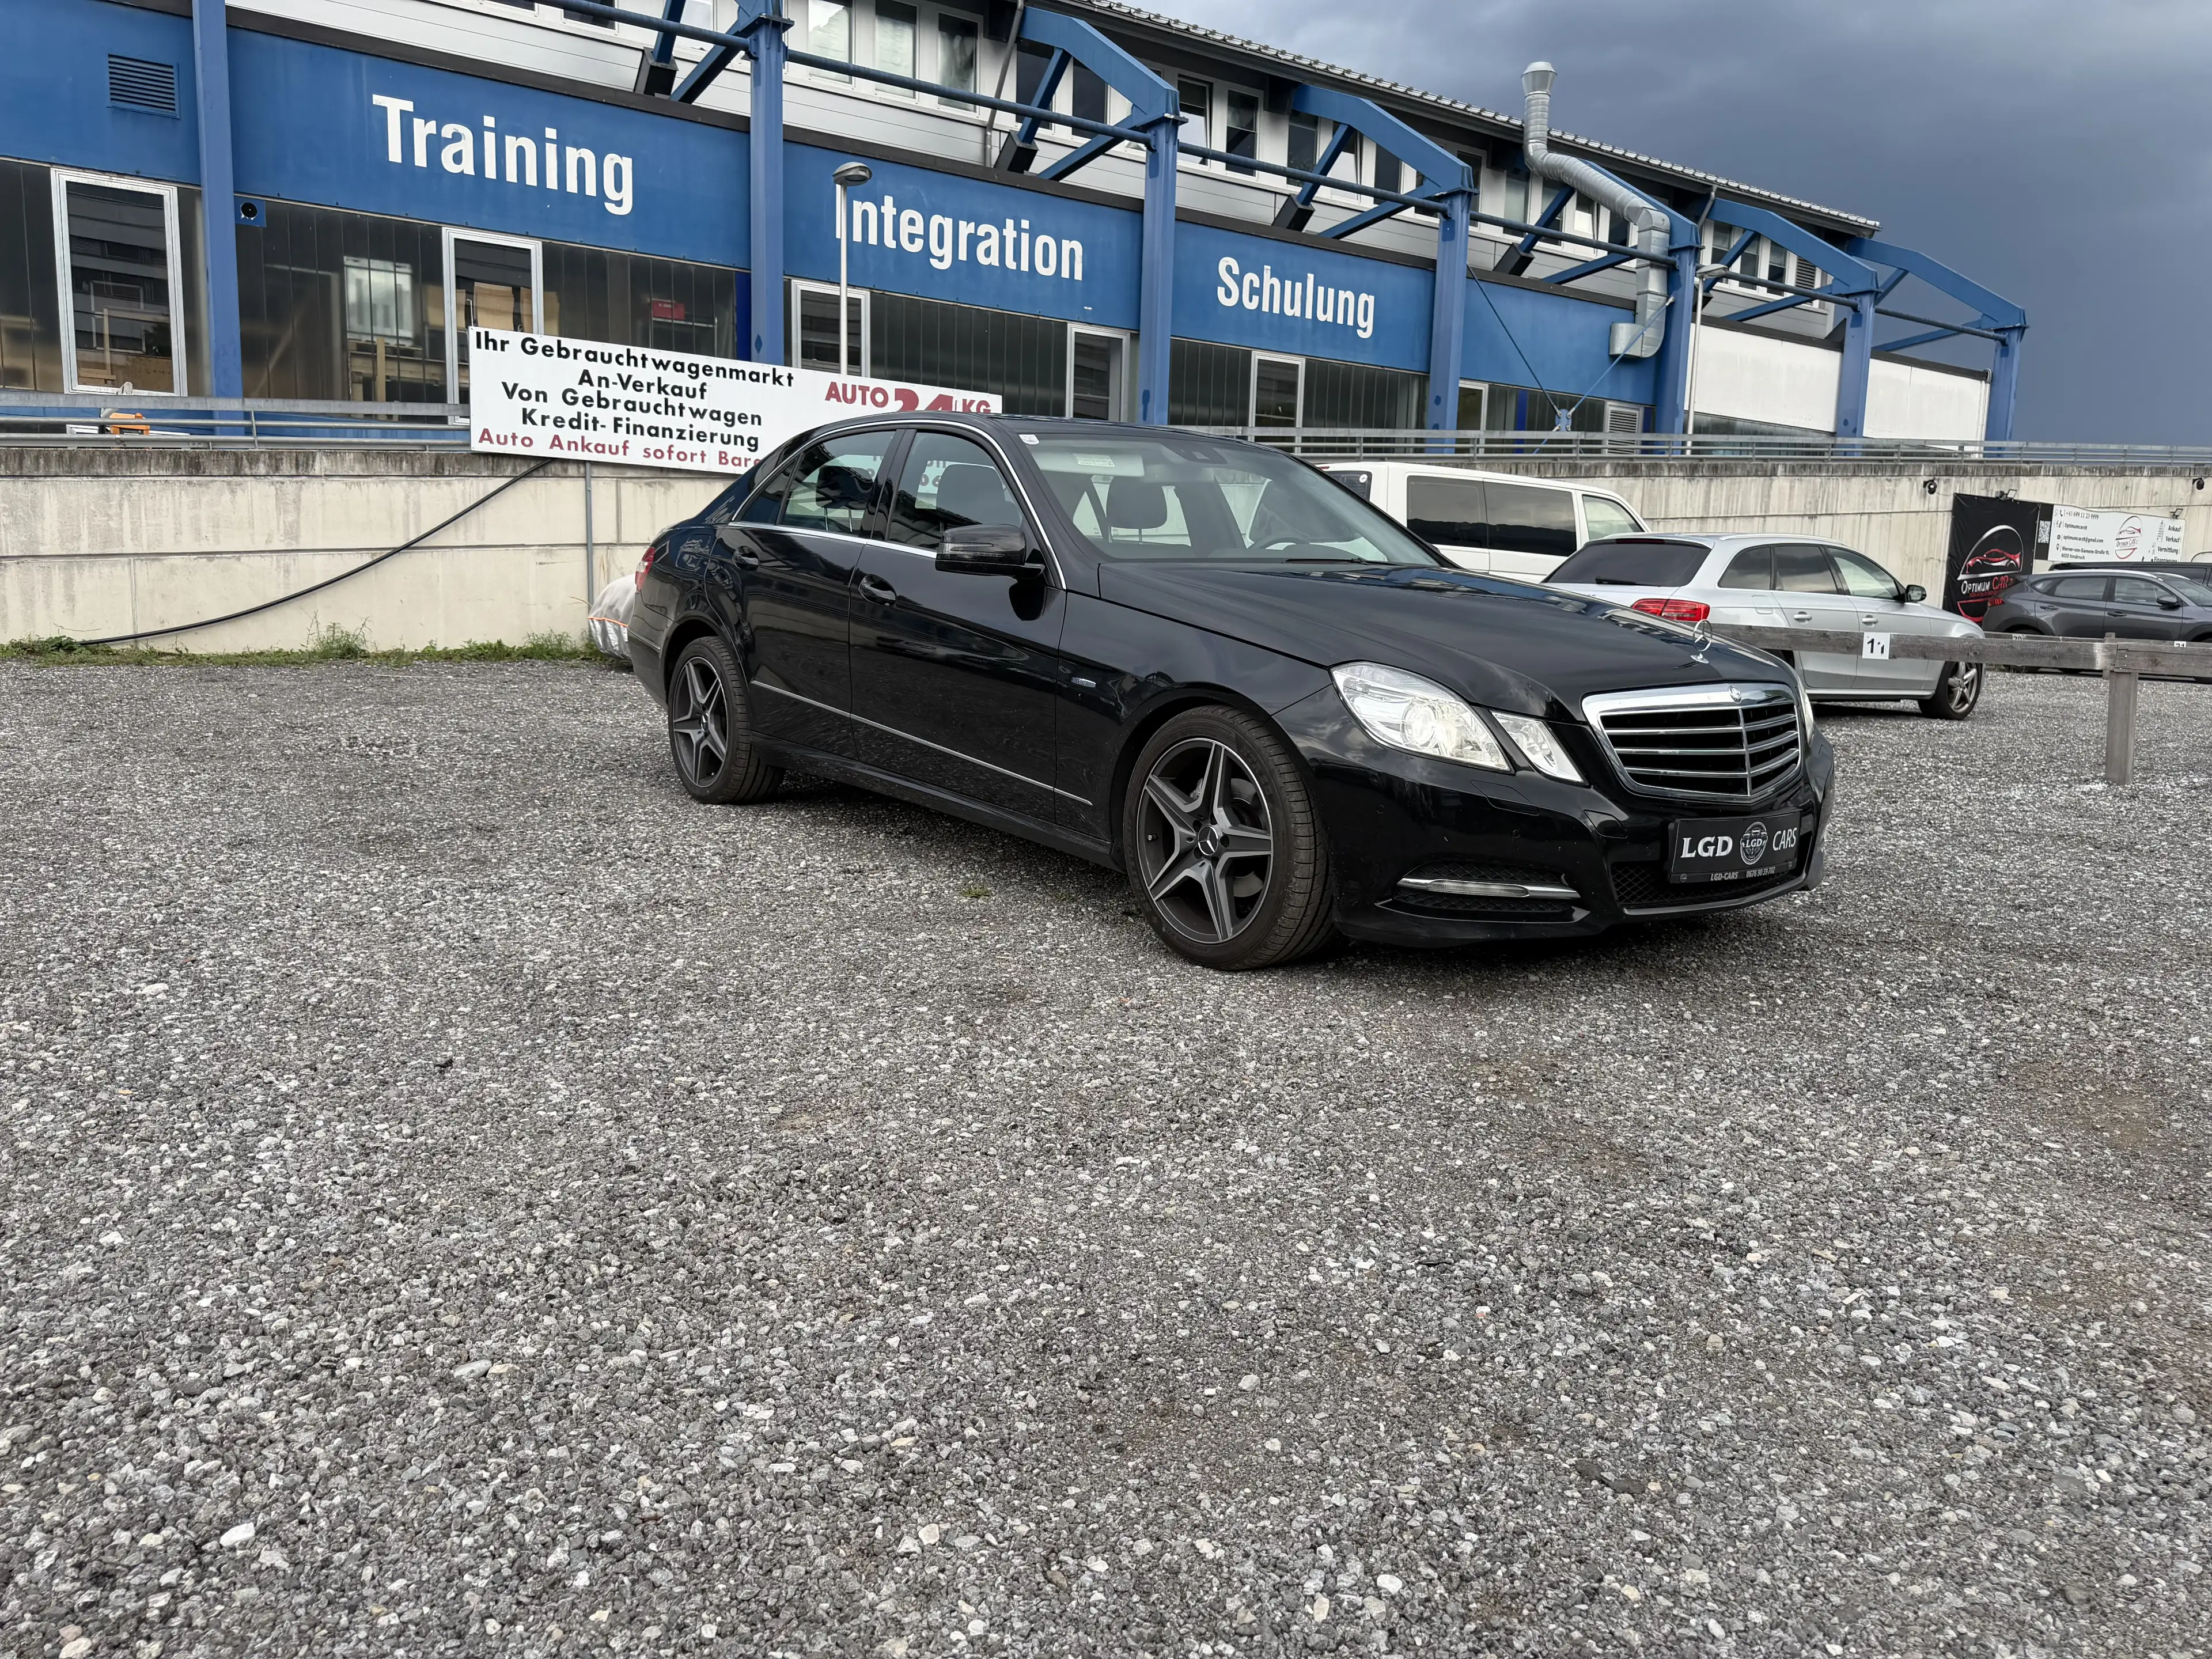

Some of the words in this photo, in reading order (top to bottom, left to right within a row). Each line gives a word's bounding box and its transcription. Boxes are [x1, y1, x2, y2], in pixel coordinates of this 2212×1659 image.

[373, 94, 633, 215] Training
[1217, 256, 1375, 339] Schulung
[475, 331, 510, 352] Ihr
[521, 337, 794, 387] Gebrauchtwagenmarkt
[578, 369, 708, 400] An-Verkauf
[825, 381, 889, 408] AUTO
[963, 398, 991, 414] KG
[501, 381, 548, 403] Von
[562, 388, 762, 427] Gebrauchtwagen
[478, 428, 534, 448] Auto
[549, 434, 630, 456] Ankauf
[643, 445, 707, 464] sofort
[522, 407, 607, 431] Kredit-
[613, 416, 759, 452] Finanzierung
[1680, 836, 1733, 858] LGD
[1772, 827, 1797, 851] CARS
[1745, 838, 1763, 848] LGD
[1710, 872, 1739, 881] LGD-CARS
